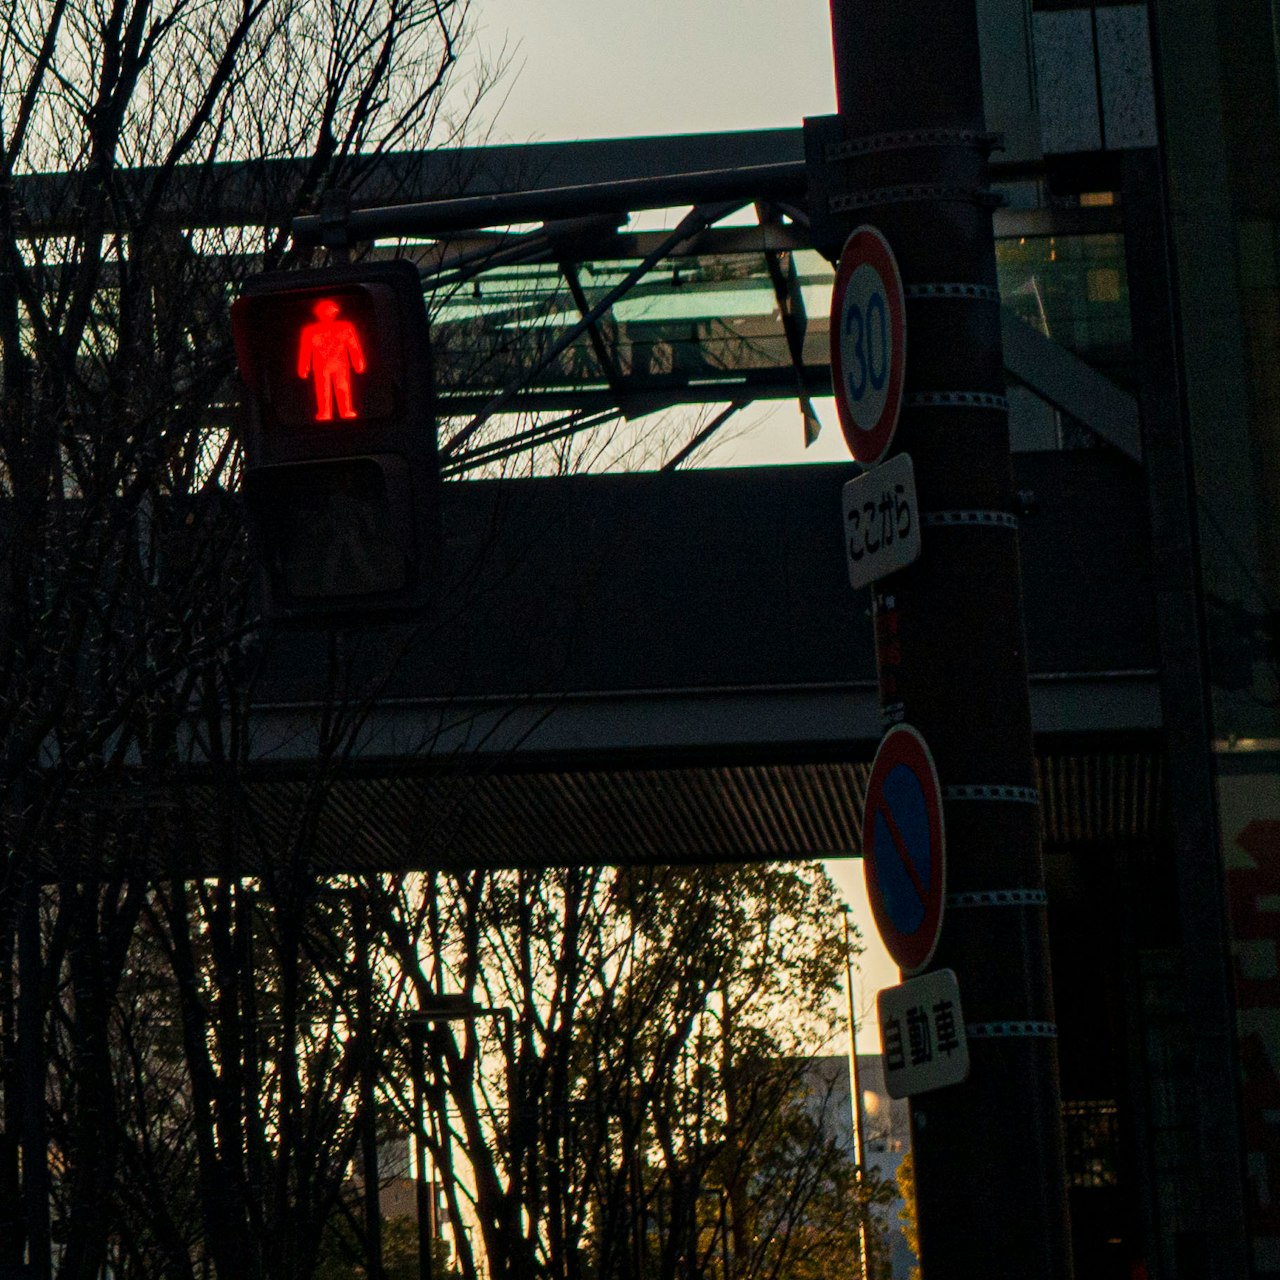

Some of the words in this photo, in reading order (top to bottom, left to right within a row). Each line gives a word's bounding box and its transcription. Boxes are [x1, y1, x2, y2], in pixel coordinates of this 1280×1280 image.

[845, 291, 887, 401] 30
[848, 484, 911, 561] ここから
[886, 1001, 960, 1071] 自動車
